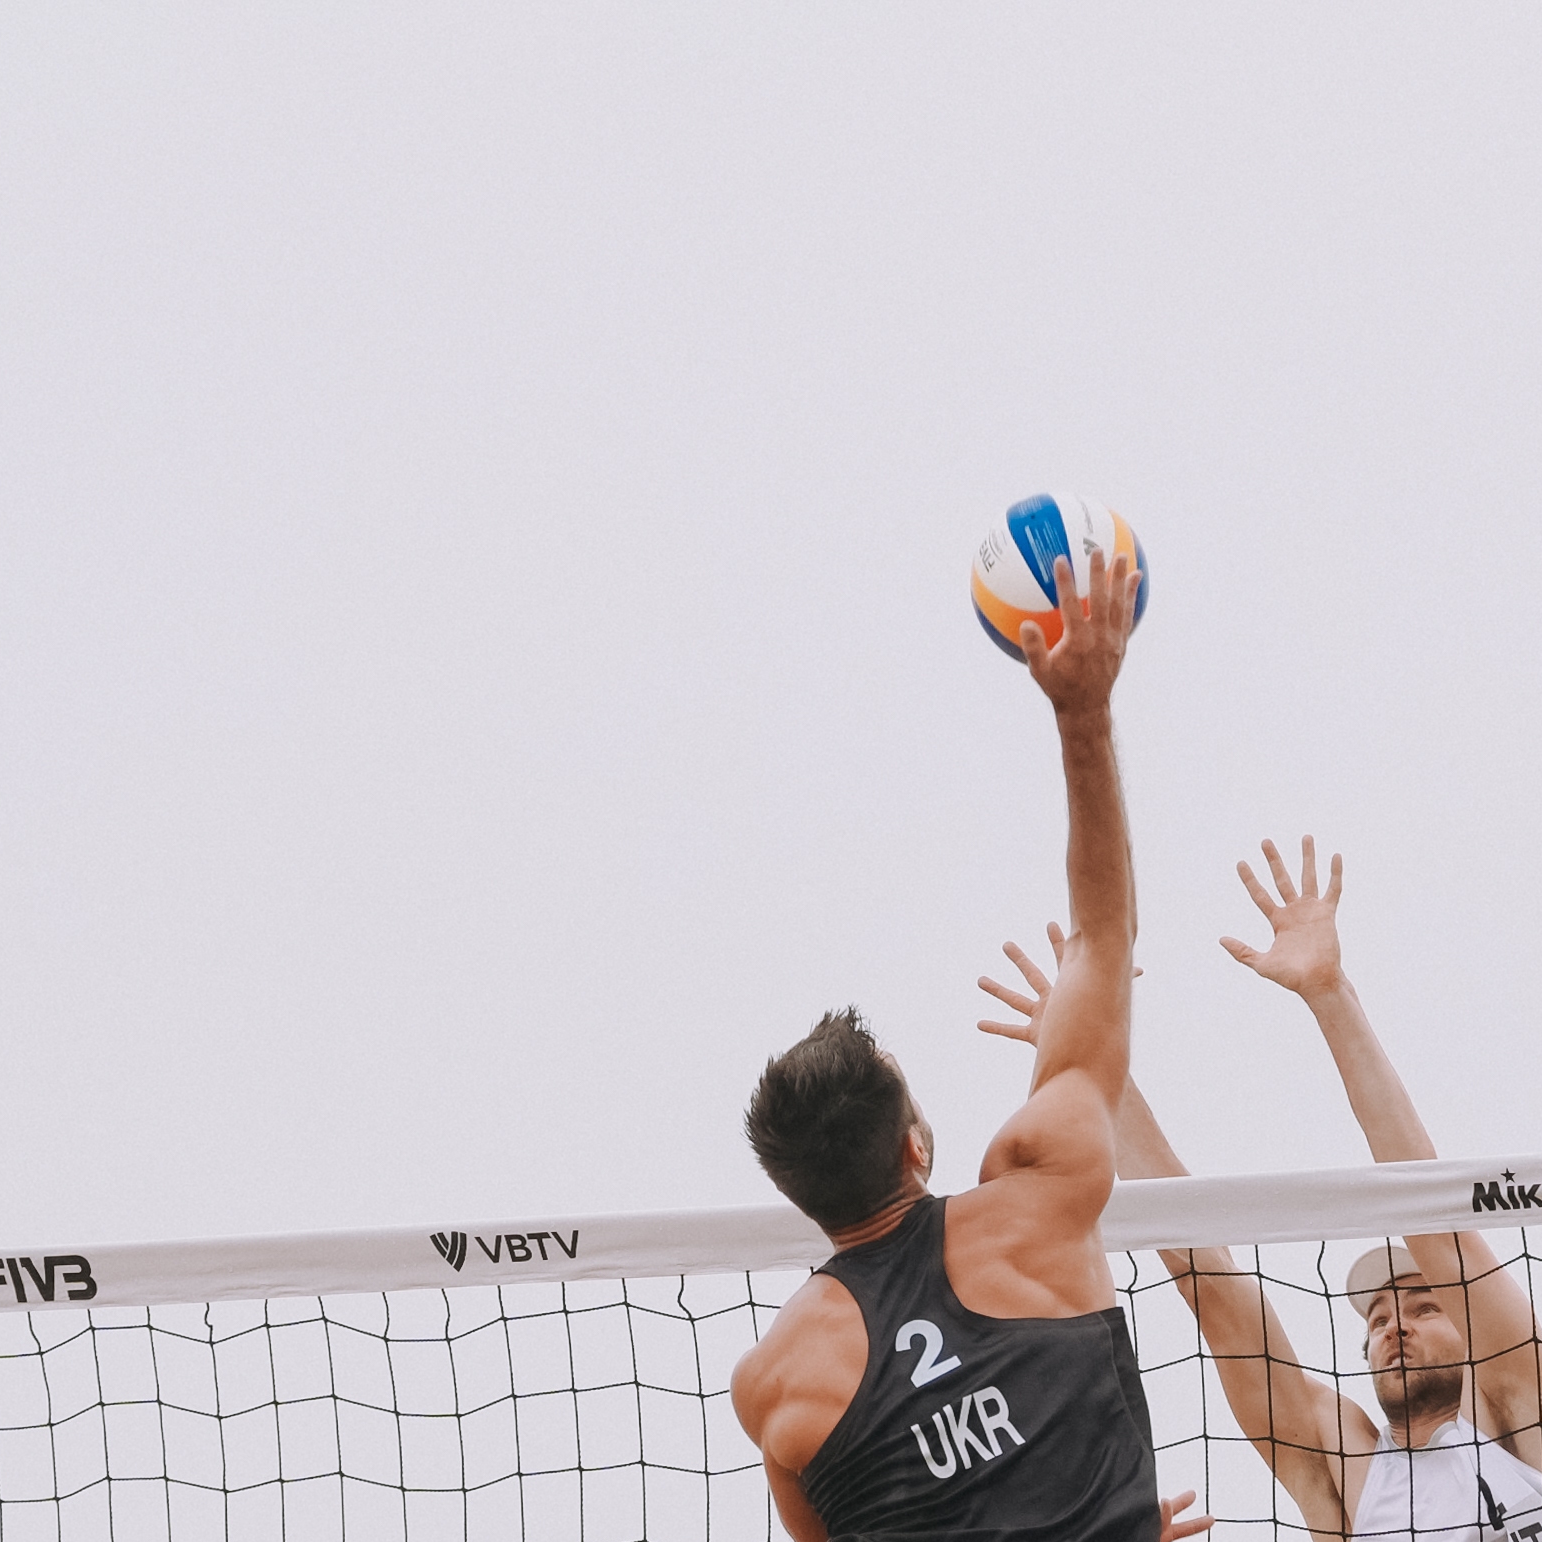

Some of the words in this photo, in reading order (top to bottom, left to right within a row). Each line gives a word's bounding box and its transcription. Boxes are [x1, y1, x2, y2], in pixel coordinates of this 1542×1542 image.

[474, 1230, 579, 1264] VBTV
[895, 1319, 962, 1388] 2
[911, 1386, 1026, 1479] UKR
